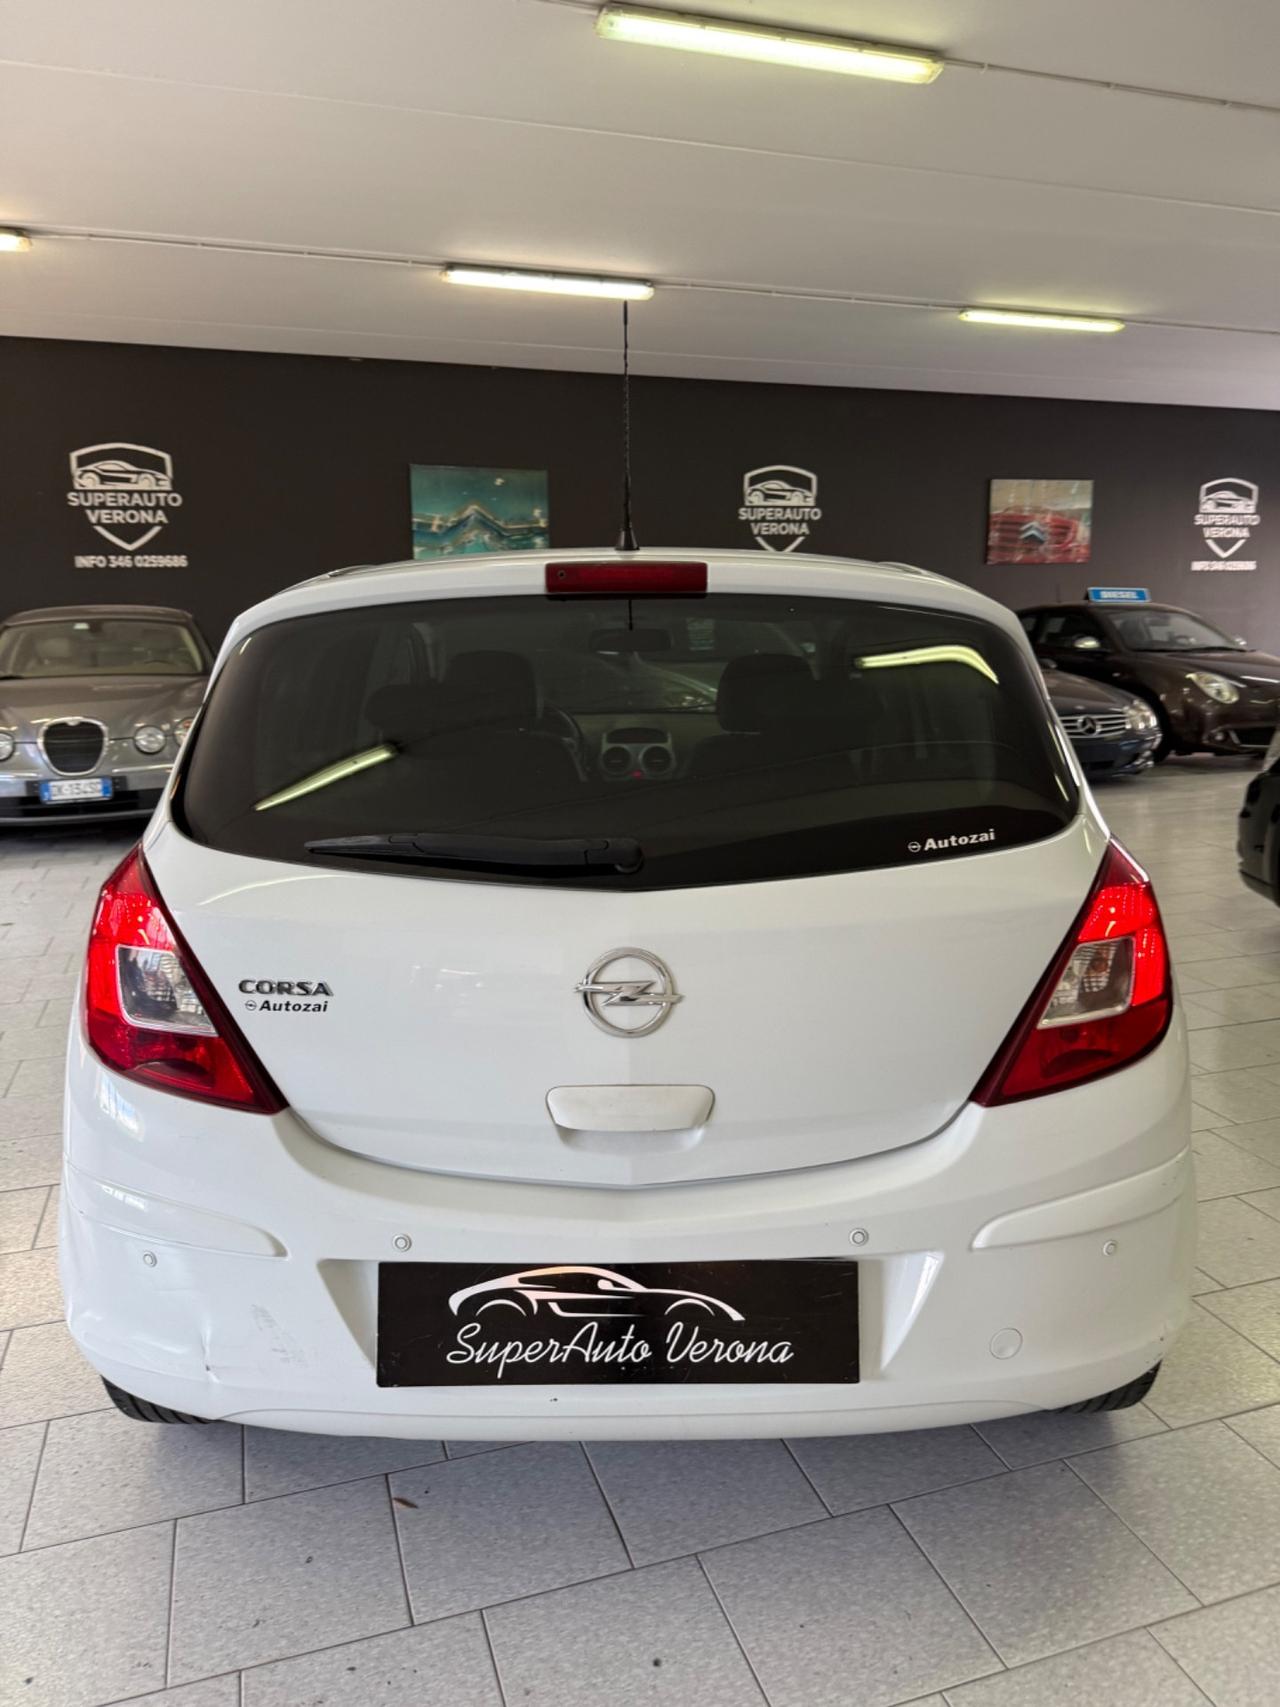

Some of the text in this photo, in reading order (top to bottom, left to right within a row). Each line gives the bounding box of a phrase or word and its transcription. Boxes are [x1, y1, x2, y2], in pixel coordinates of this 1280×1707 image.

[66, 491, 183, 507] SUPERAUTO
[85, 509, 169, 524] VERONA
[738, 507, 822, 520] SUPERAUTO
[1193, 514, 1261, 526] SUPERAUTO
[750, 522, 810, 535] VERONA
[74, 555, 107, 568] INFO
[924, 828, 995, 851] Autozai
[238, 979, 334, 996] CORSA
[259, 1000, 328, 1012] Autozai
[446, 1321, 794, 1379] SuperAuto Verona
